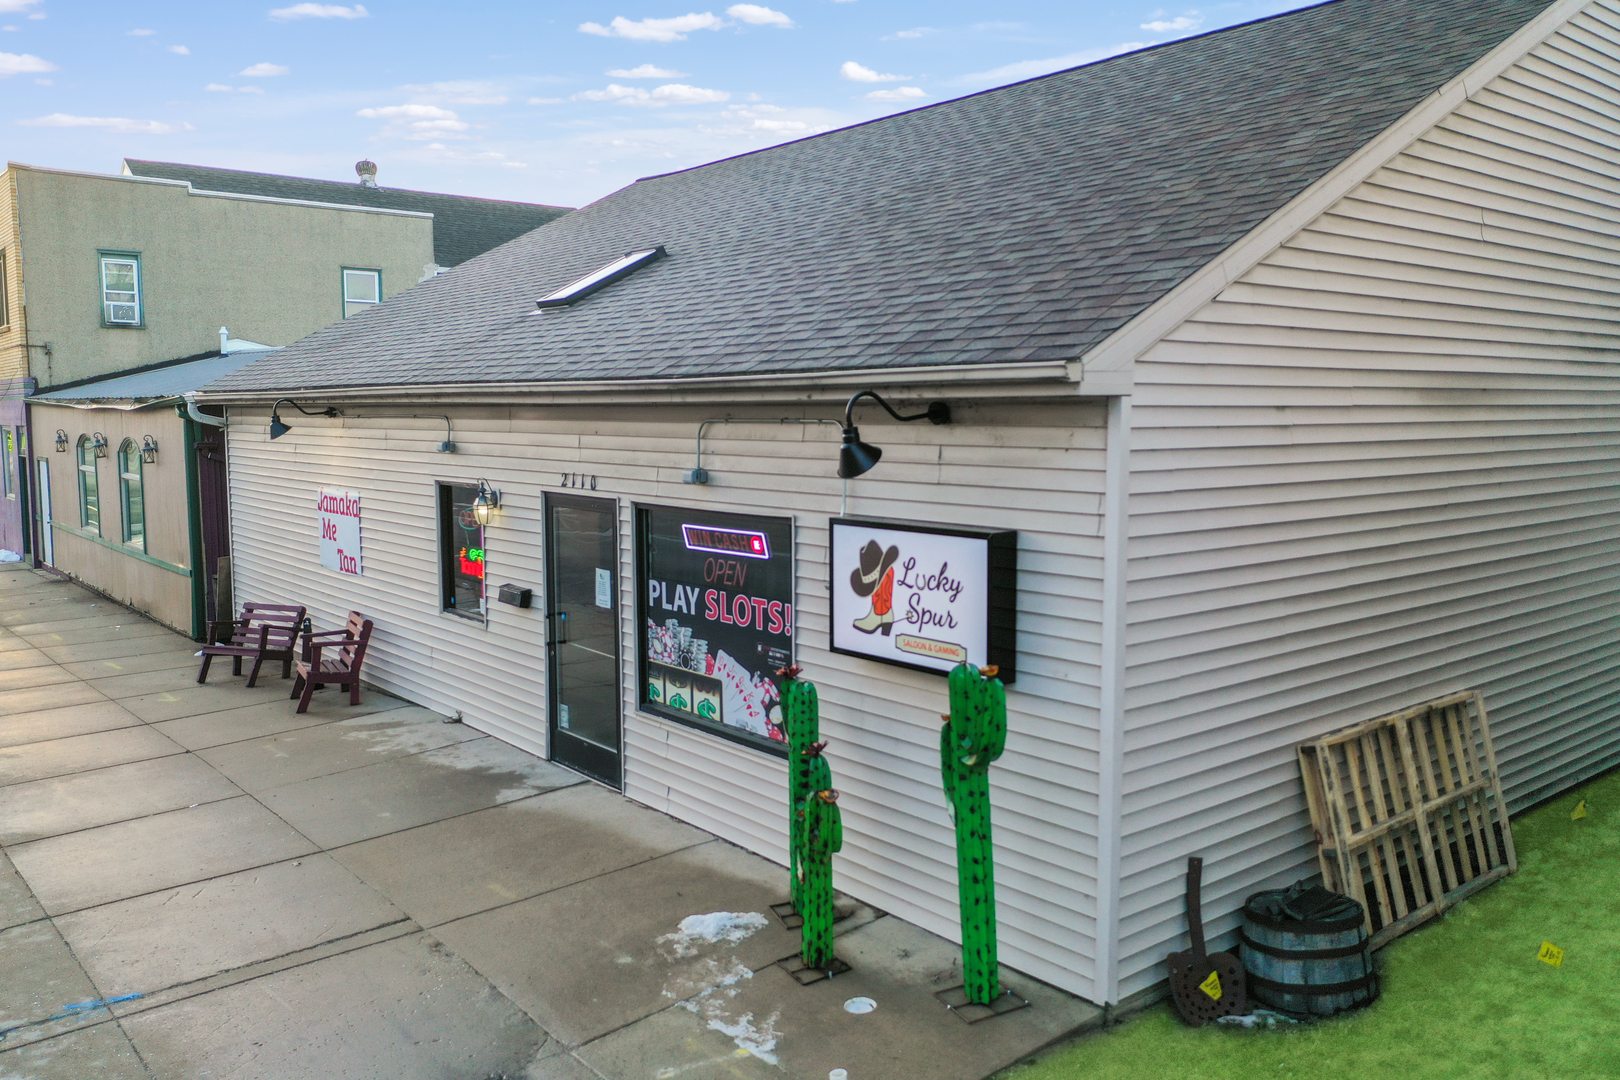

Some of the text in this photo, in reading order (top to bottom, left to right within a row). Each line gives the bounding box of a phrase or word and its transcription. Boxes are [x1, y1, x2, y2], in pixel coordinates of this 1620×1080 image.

[560, 472, 597, 491] 2110
[317, 486, 360, 518] Jamaka
[322, 517, 338, 542] Me
[686, 528, 750, 552] WIN CASH
[336, 548, 358, 575] Tan
[703, 557, 748, 587] OPEN
[896, 557, 964, 603] Lucky
[648, 579, 792, 636] PLAY SLOTS!
[906, 592, 959, 633] Spur
[902, 638, 961, 658] SALOON & GAMING
